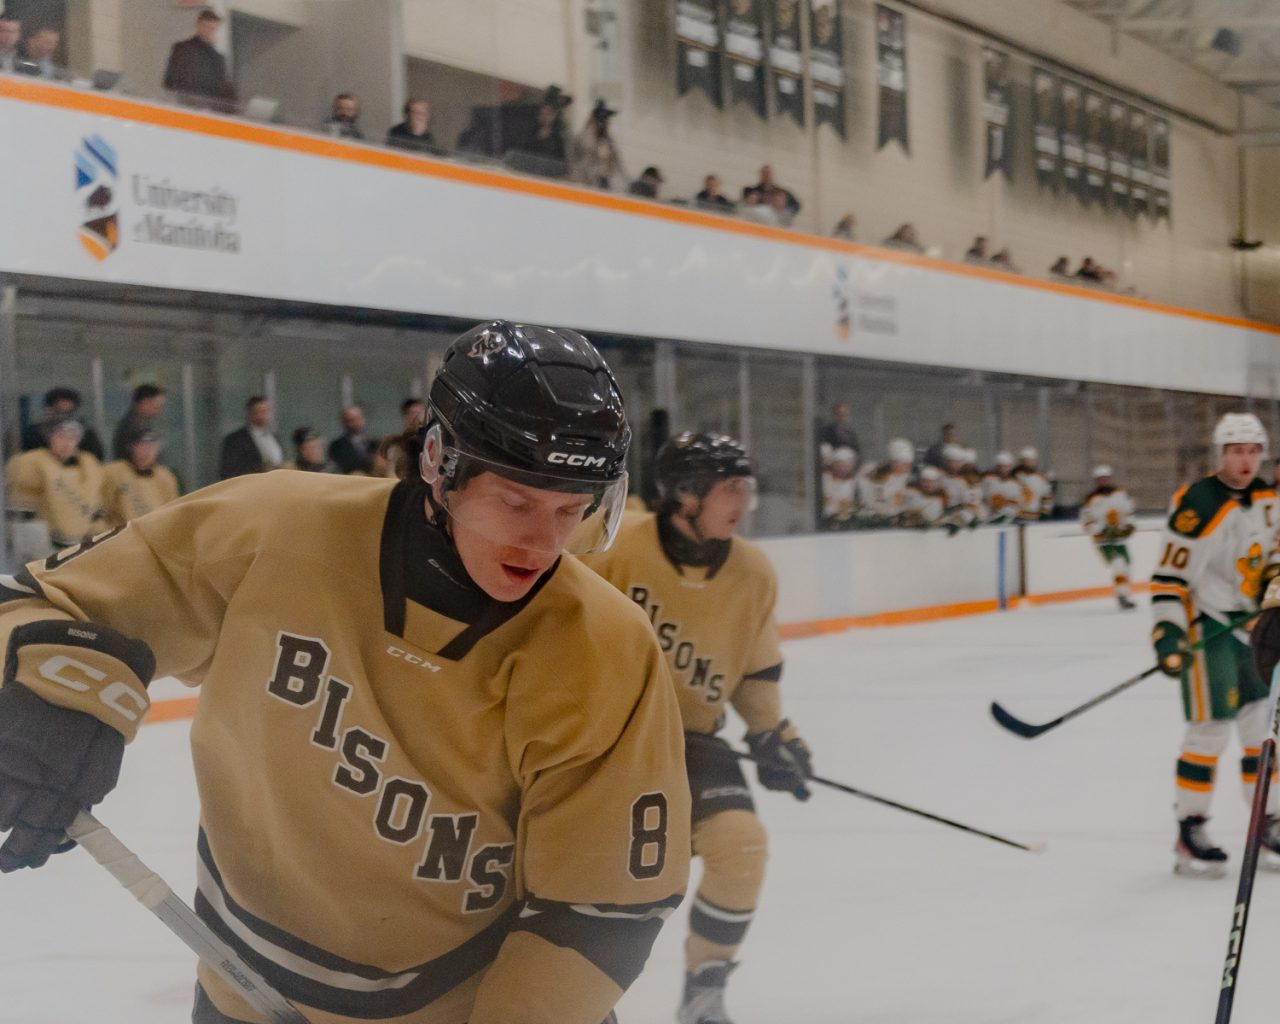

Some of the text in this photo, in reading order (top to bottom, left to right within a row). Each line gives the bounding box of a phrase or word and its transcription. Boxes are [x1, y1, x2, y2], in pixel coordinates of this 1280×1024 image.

[547, 452, 607, 468] CCM
[1159, 542, 1192, 569] 10
[67, 627, 98, 641] BISONS
[386, 646, 441, 673] CCM
[39, 655, 148, 722] CC
[267, 630, 516, 915] BISONS
[626, 791, 669, 881] 8
